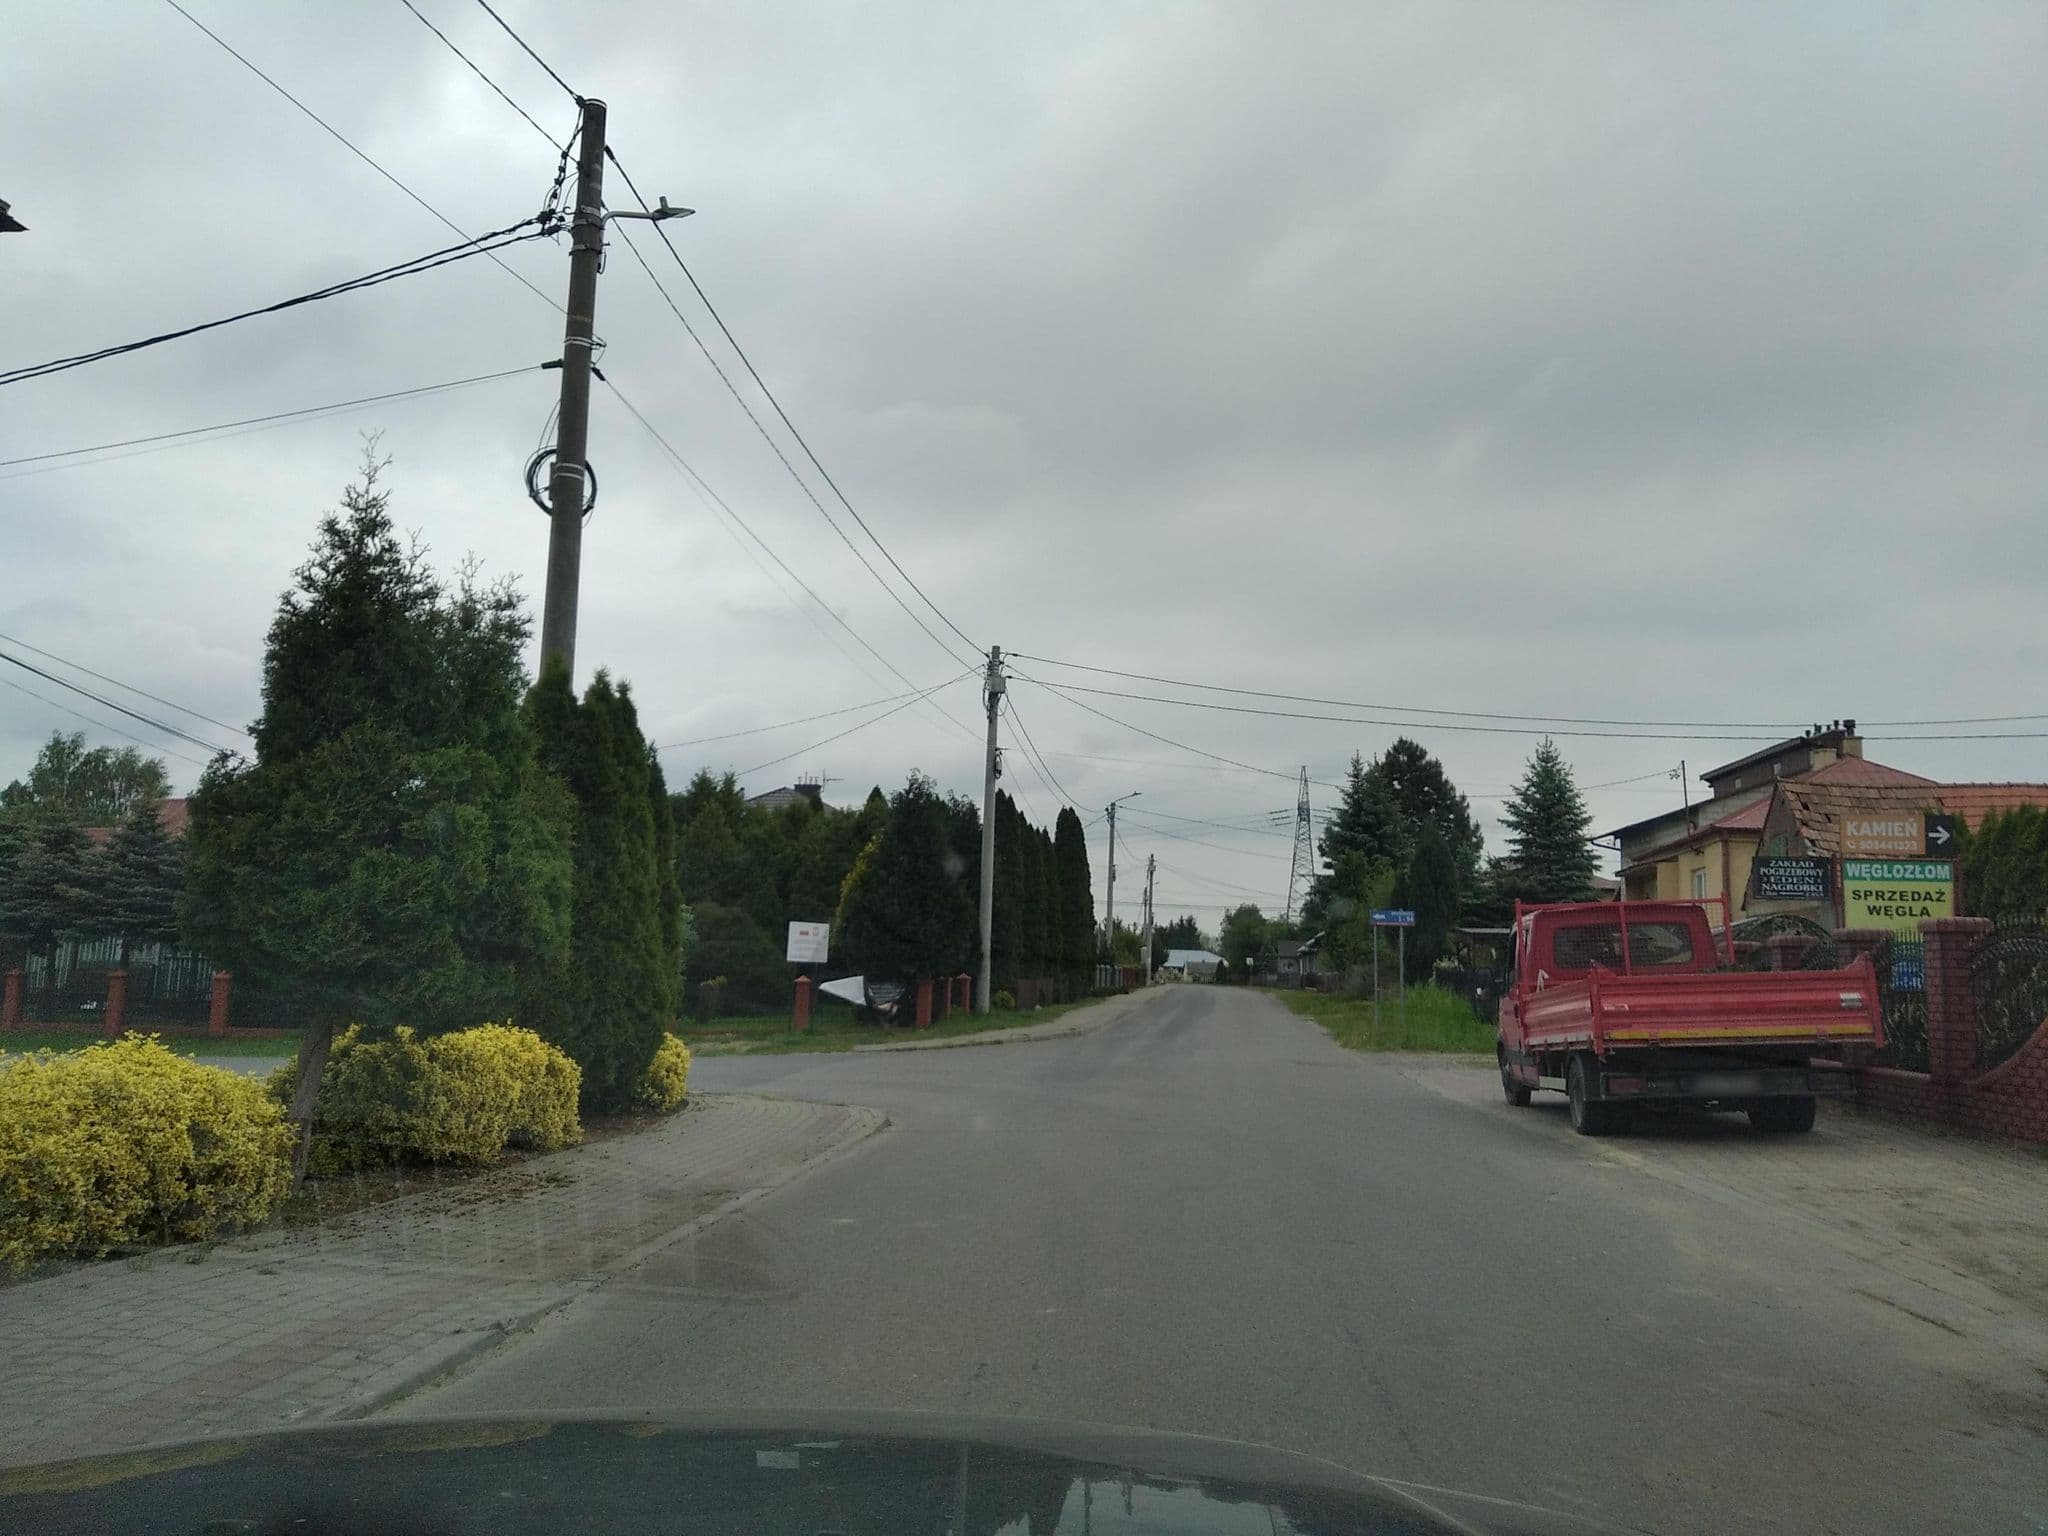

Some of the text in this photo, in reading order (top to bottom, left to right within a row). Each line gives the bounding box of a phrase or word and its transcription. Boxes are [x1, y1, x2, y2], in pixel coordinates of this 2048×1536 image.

[1847, 818, 1916, 836] KAMIEŃ
[1760, 867, 1823, 876] POGRZEBOWY
[1846, 863, 1950, 880] WĘGLOZŁOM
[1761, 883, 1823, 891] NAGROBKI
[1852, 889, 1946, 902] SPRZEDAŻ
[1867, 905, 1931, 919] WĘGLA
